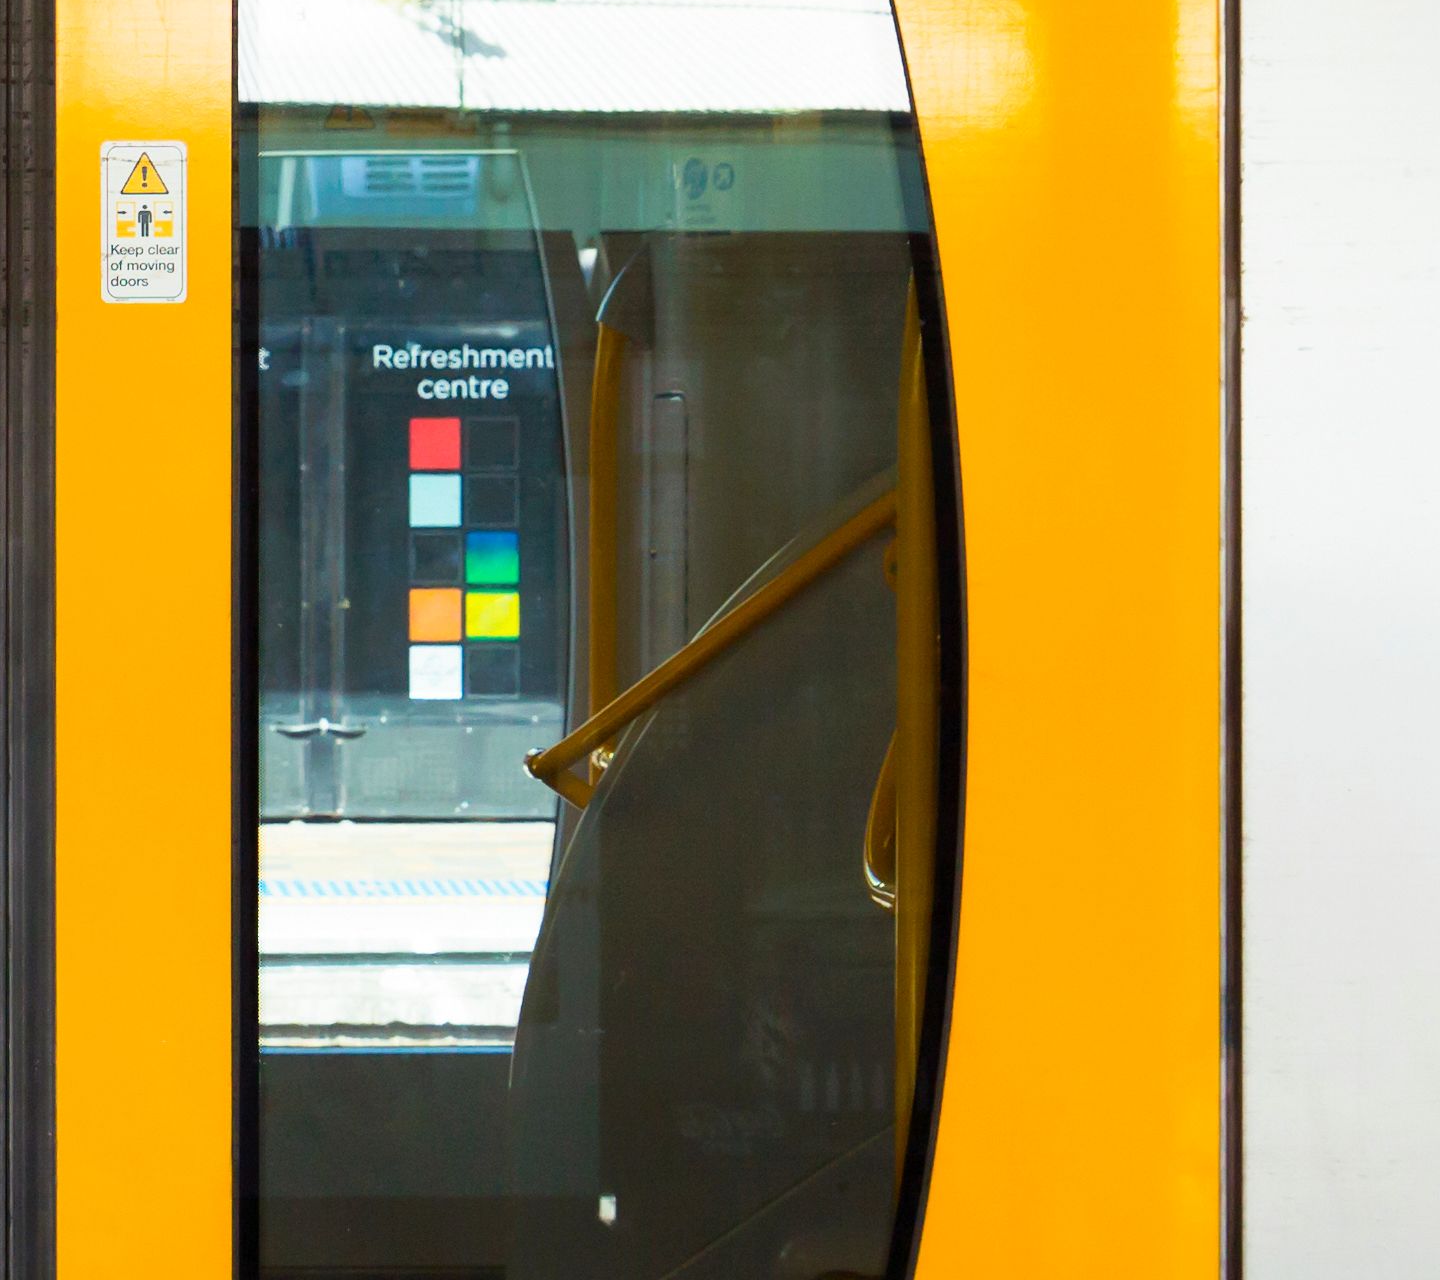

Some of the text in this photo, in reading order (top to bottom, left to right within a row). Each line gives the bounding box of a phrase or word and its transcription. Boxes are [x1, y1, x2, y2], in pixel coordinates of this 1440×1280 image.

[110, 244, 180, 258] Keep clear
[110, 260, 175, 274] of moving
[110, 276, 149, 287] doors
[372, 343, 555, 369] Refreshment
[417, 375, 510, 401] centre
